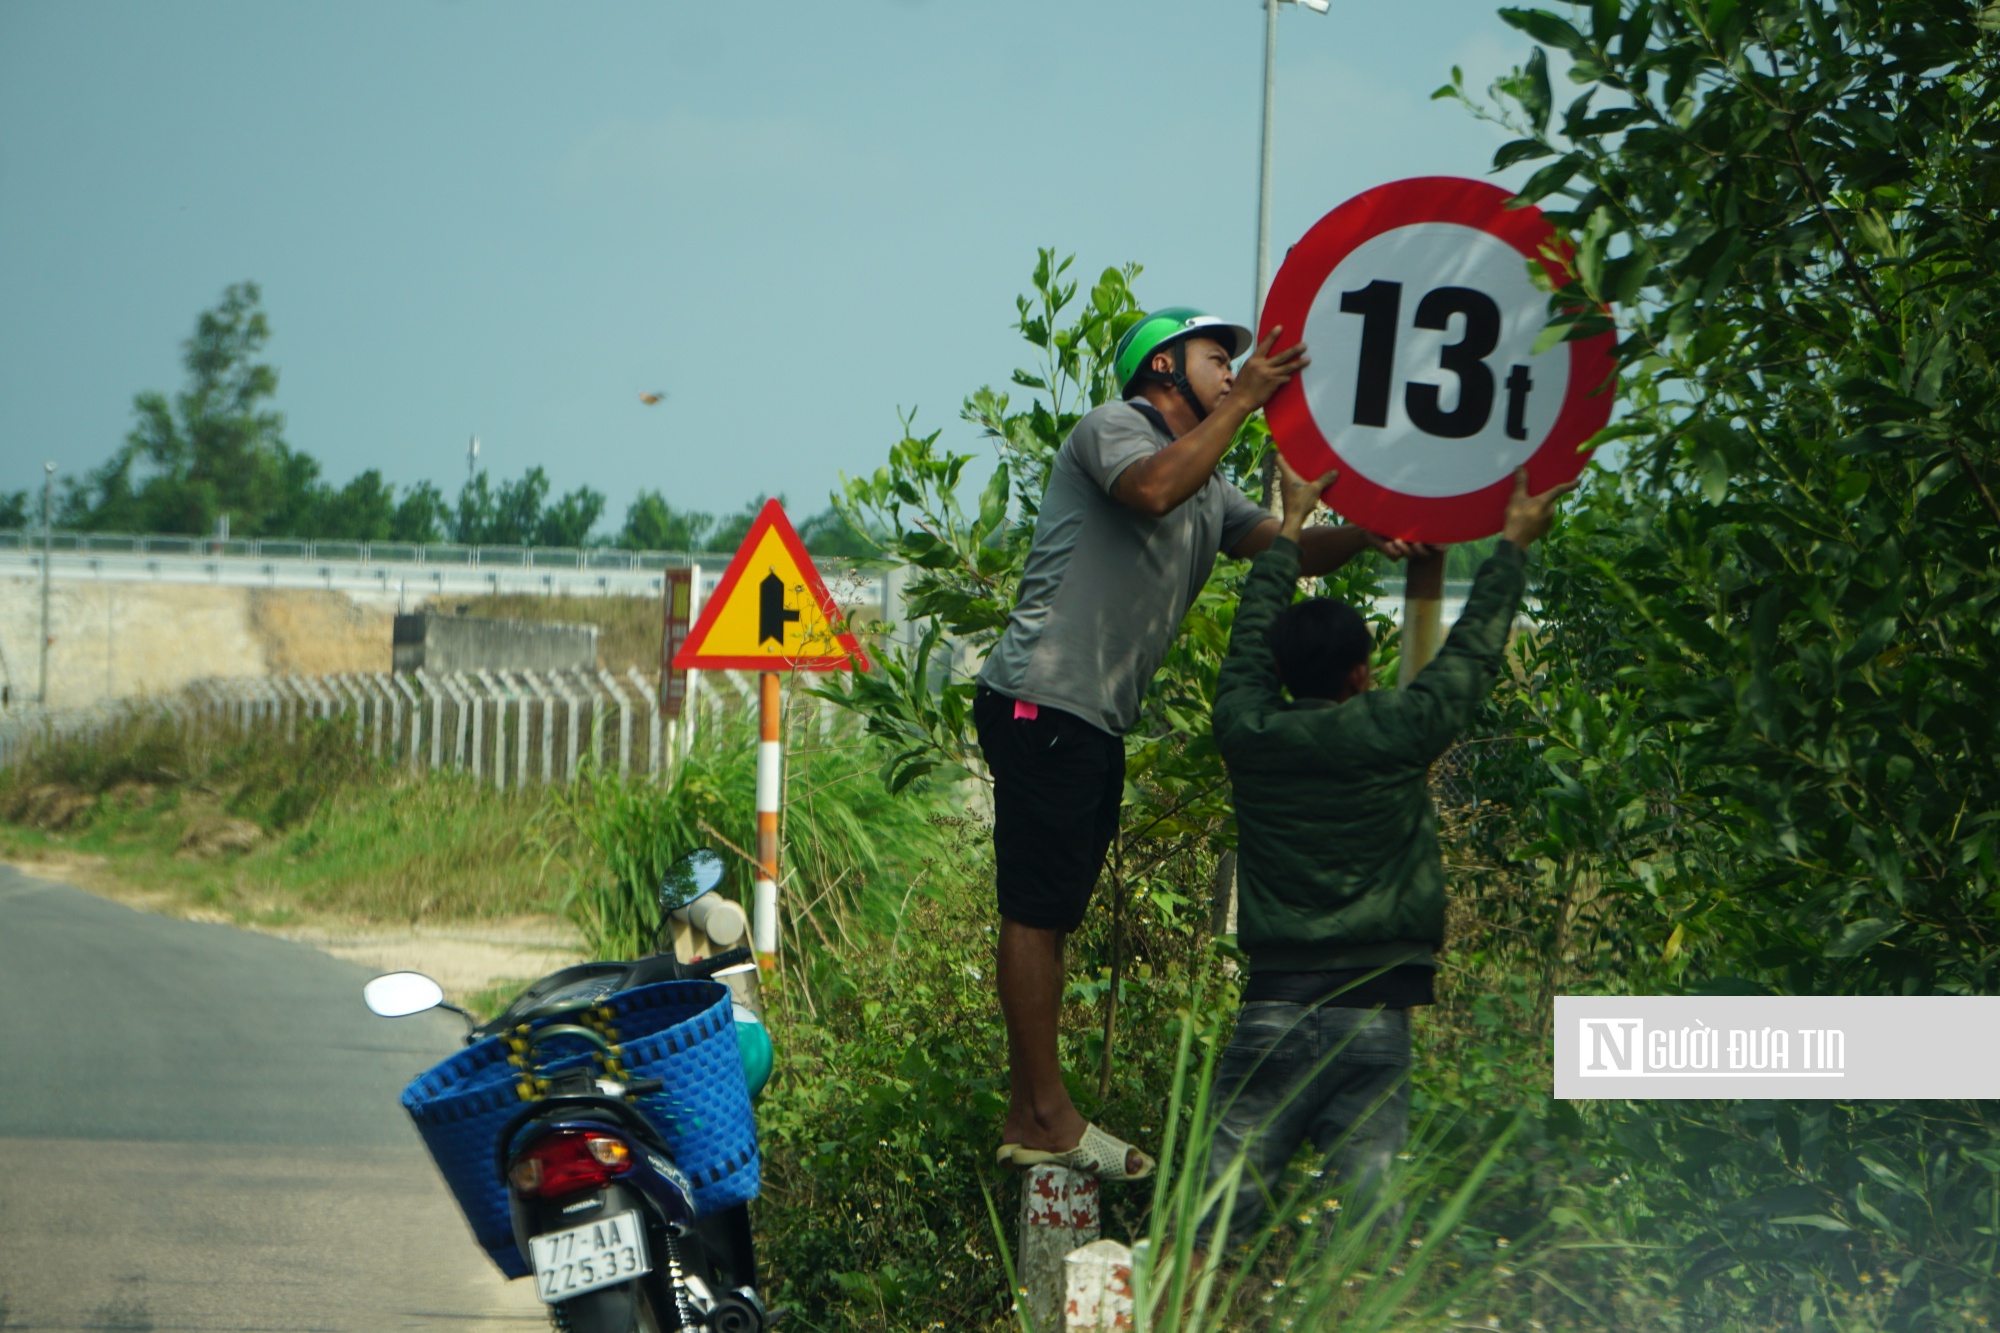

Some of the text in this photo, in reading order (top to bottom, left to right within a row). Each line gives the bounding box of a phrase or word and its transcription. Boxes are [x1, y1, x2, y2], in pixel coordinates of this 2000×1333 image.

[562, 1199, 600, 1214] HONDA
[546, 1220, 622, 1264] 77-AA
[542, 1246, 636, 1295] 225.33
